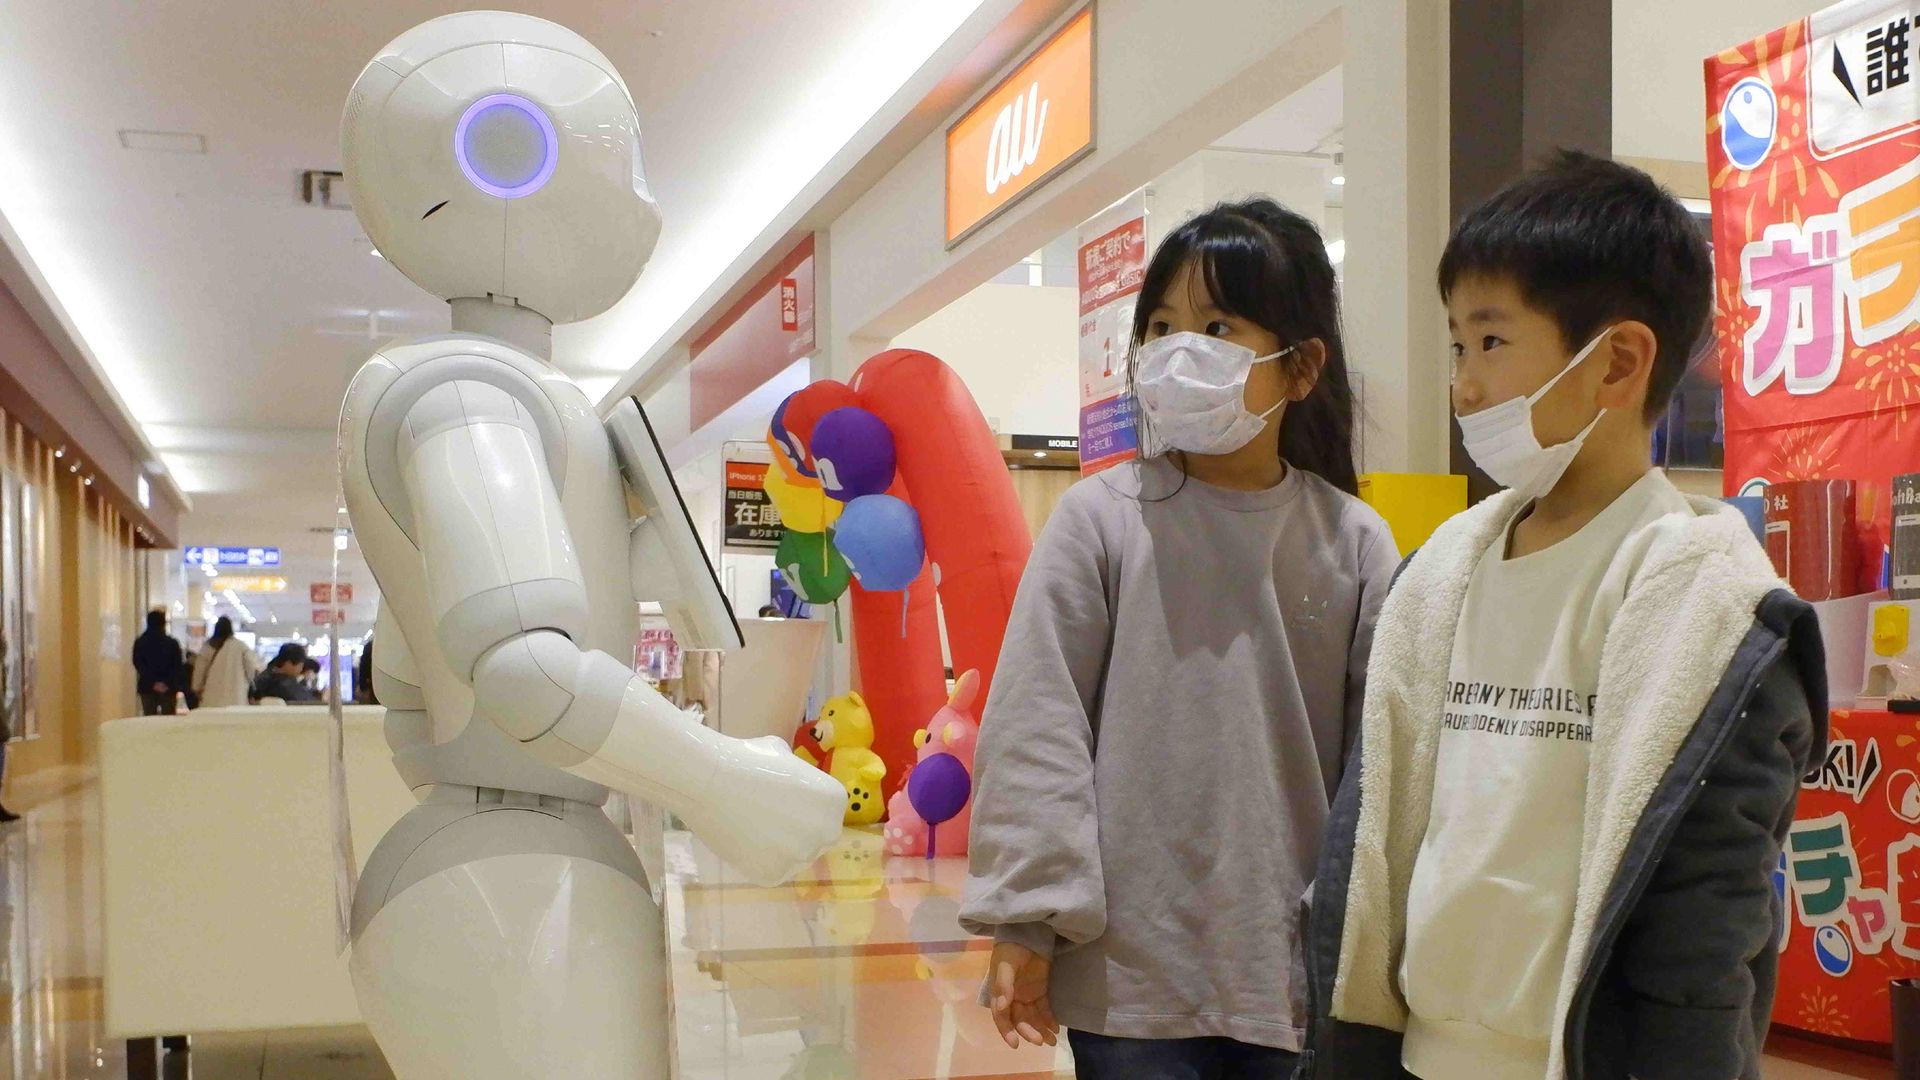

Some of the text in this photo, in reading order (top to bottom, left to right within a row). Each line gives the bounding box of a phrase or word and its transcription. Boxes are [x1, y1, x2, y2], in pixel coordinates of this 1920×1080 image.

[1866, 16, 1920, 96] 誰
[986, 81, 1048, 194] au
[1048, 440, 1078, 448] MOBILE
[734, 502, 781, 526] 在庫
